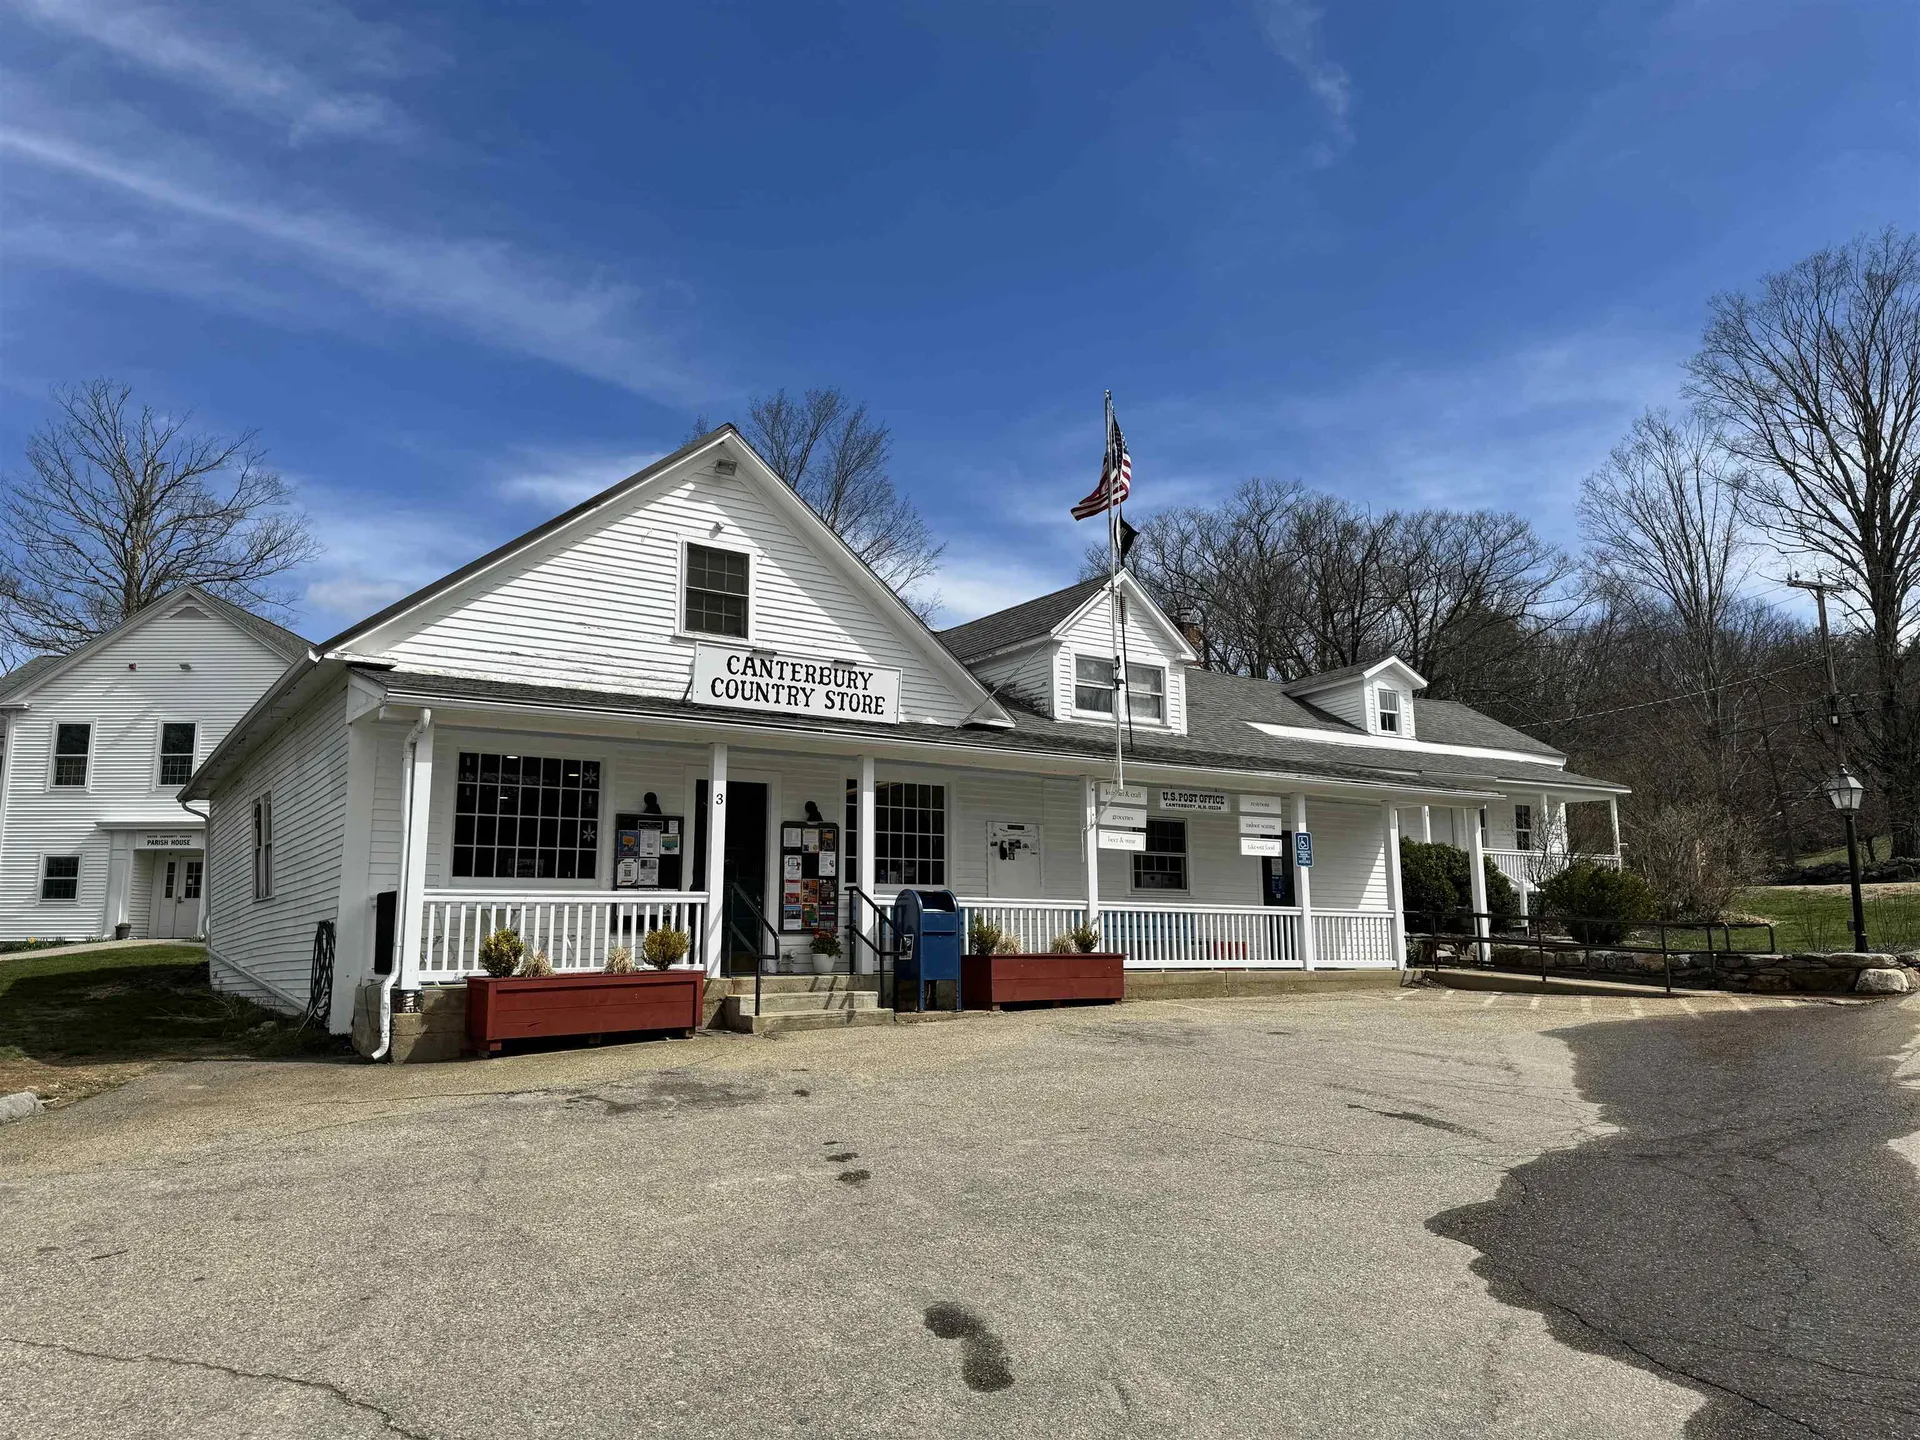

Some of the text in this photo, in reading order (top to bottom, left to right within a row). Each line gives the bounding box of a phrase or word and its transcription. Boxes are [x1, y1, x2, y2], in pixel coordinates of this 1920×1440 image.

[726, 655, 873, 691] CANTERBURY
[710, 677, 886, 715] COUNTRY STORE
[715, 793, 724, 805] 3
[1162, 791, 1225, 805] U.S. POST OFFICE
